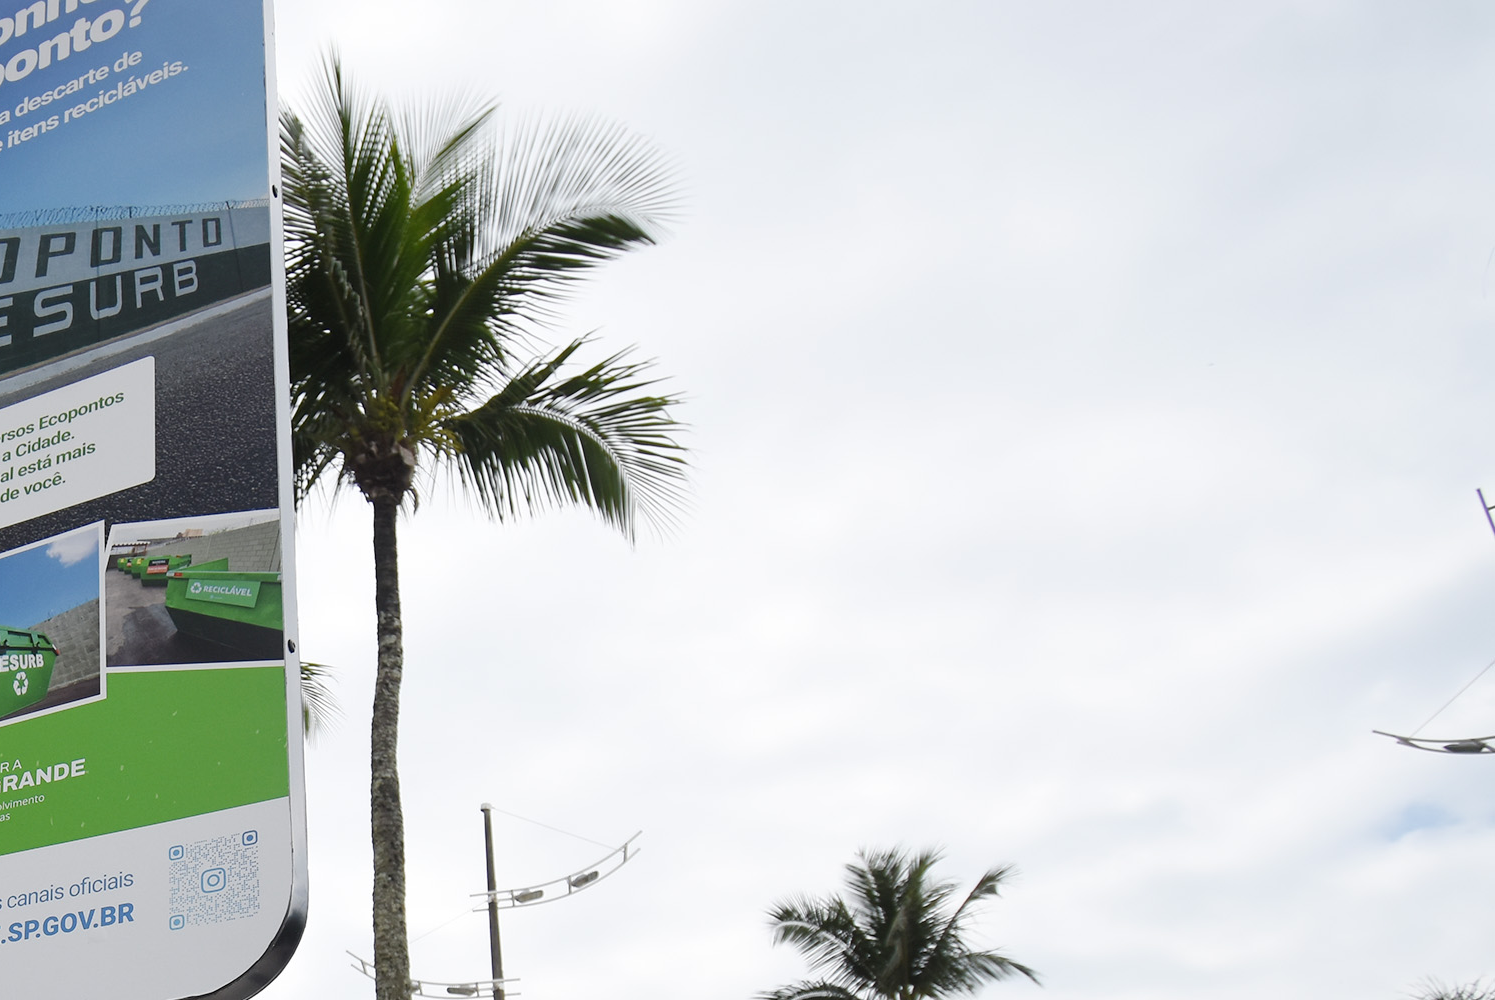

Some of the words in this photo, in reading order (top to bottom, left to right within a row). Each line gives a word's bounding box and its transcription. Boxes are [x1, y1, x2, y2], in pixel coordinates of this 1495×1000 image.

[15, 66, 109, 117] descarte
[113, 51, 143, 73] de
[7, 115, 59, 149] itens
[64, 60, 189, 123] recicláveis.
[39, 392, 124, 430] Ecopontos
[2, 451, 11, 462] a
[15, 430, 75, 457] Cidade.
[17, 456, 52, 477] está
[56, 442, 96, 465] mais
[0, 488, 19, 504] de
[24, 472, 66, 496] você.
[203, 584, 253, 597] RECICLÁVEL
[7, 884, 64, 909] canais
[69, 871, 134, 897] oficiais
